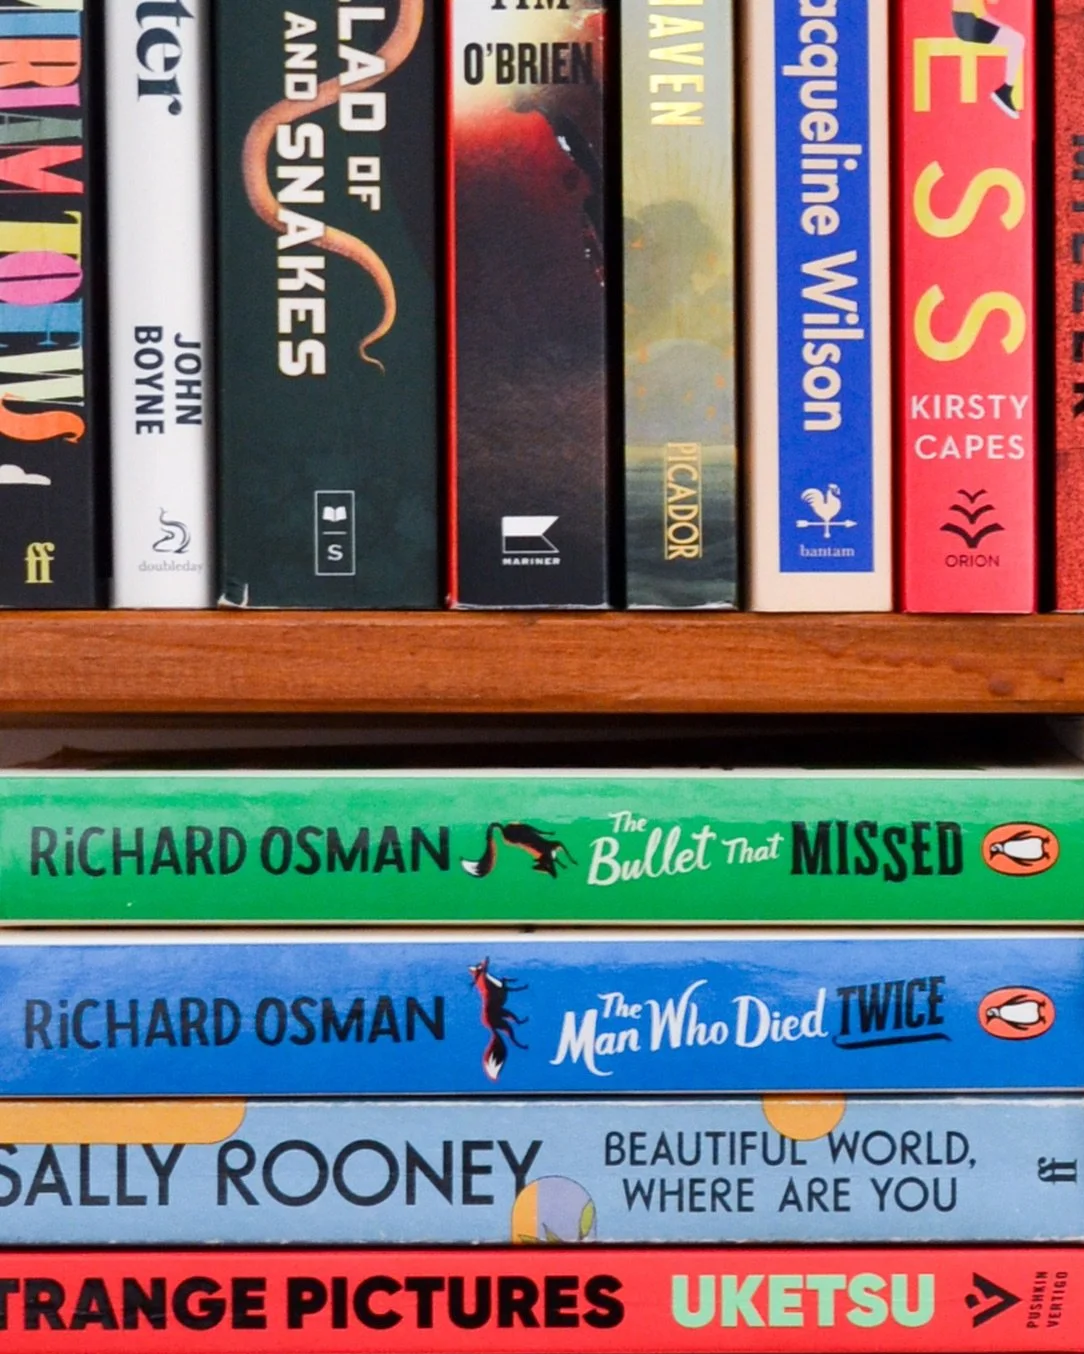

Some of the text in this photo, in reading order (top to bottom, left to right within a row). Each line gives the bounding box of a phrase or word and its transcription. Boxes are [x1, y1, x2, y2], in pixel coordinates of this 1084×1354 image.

[463, 42, 593, 85] O'BRIEN
[276, 11, 326, 376] AND SNAKES
[348, 156, 380, 210] OF
[800, 249, 864, 432] Wilson
[134, 326, 164, 434] BOYNE
[175, 332, 202, 425] JOHN
[911, 395, 1028, 420] KIRSTY
[914, 434, 1026, 459] CAPES
[666, 443, 698, 559] PICADOR
[138, 559, 204, 573] doubleday
[502, 555, 561, 566] MARINER
[800, 543, 855, 558] bantam
[945, 554, 1000, 568] ORION
[260, 825, 452, 876] OSMAN
[587, 810, 965, 887] The Bullet That MISSED
[254, 995, 446, 1044] OSMAN
[549, 975, 946, 1077] Man Who Died TWICE
[597, 990, 643, 1021] The
[0, 1138, 544, 1208] SALLY ROONEY
[604, 1130, 977, 1170] BEAUTIFUL WORLD,
[622, 1176, 959, 1214] WHERE ARE YOU
[287, 1273, 937, 1330] PICTURES UKETSU
[1026, 1271, 1048, 1329] PUSHKIN
[1046, 1271, 1069, 1328] VERTIGO
